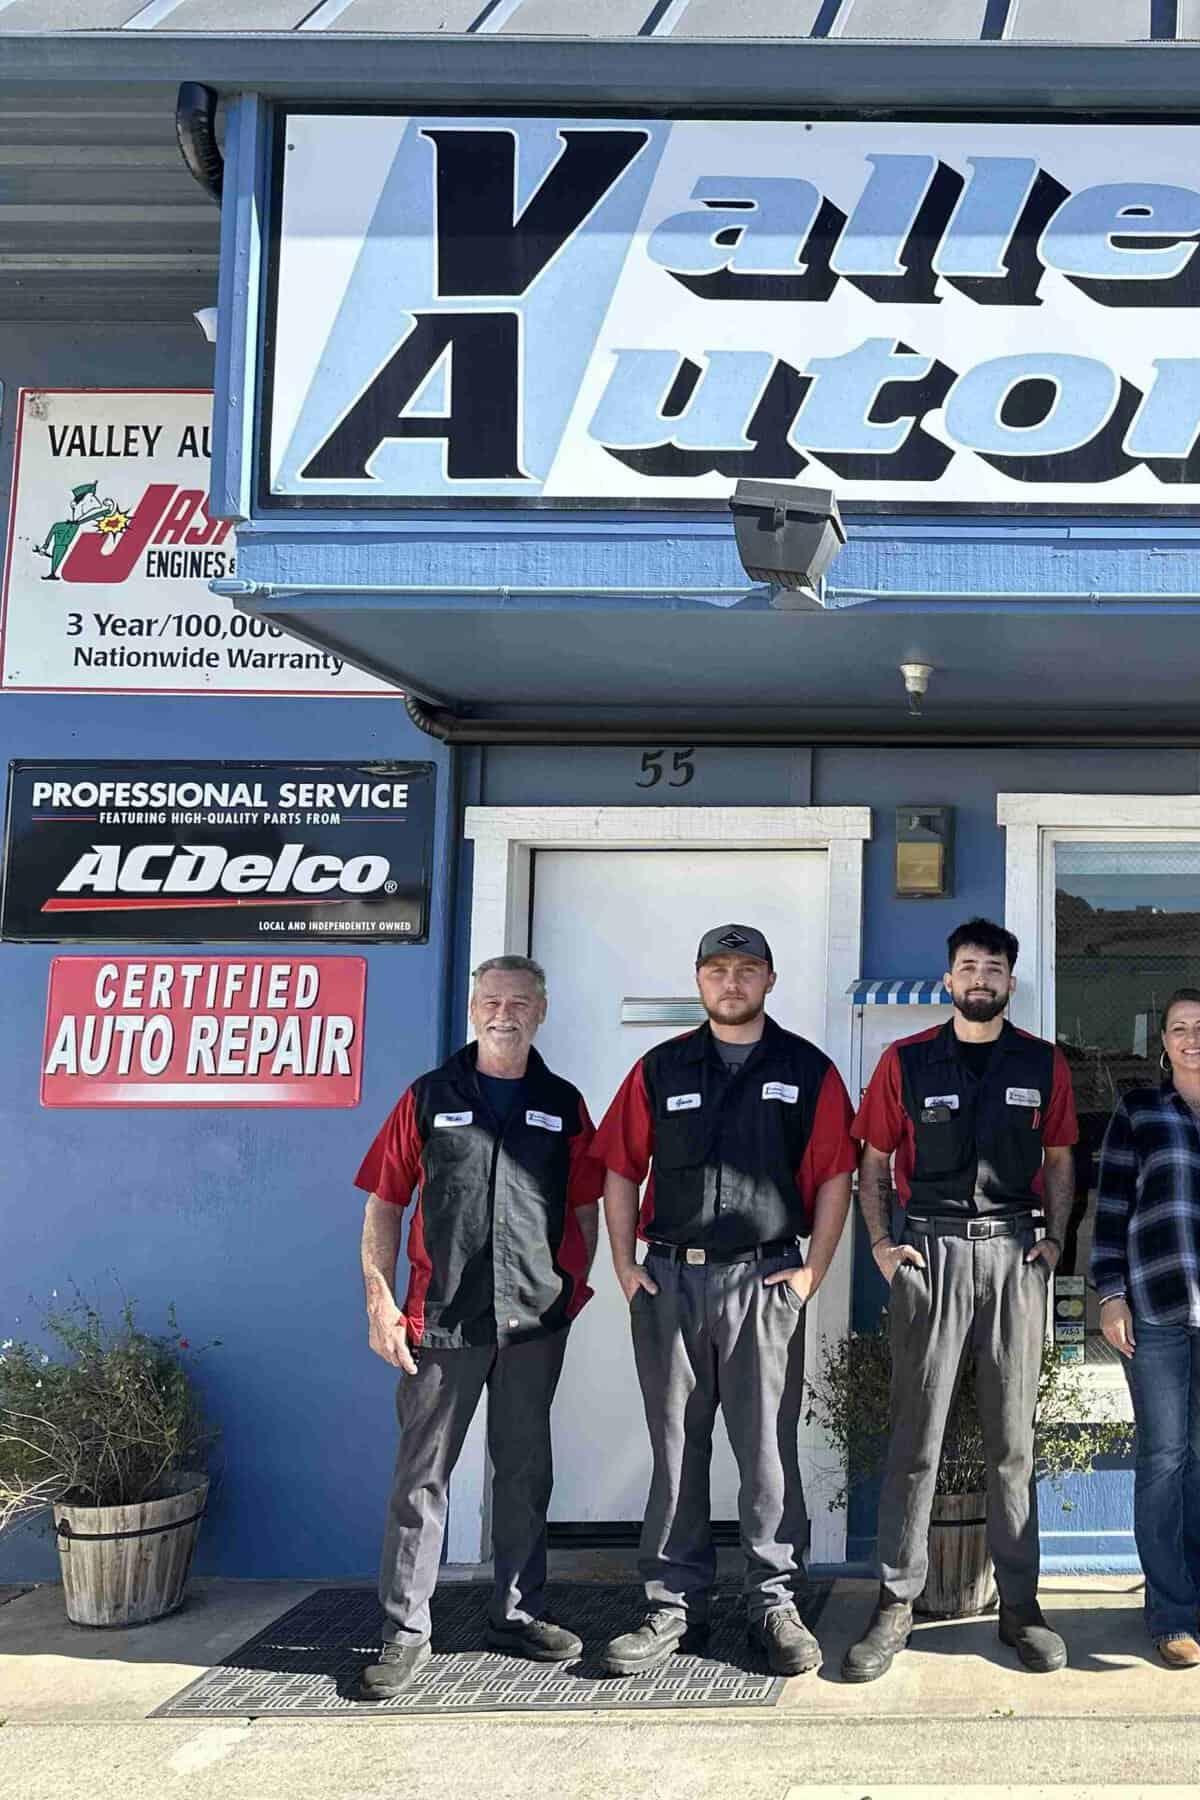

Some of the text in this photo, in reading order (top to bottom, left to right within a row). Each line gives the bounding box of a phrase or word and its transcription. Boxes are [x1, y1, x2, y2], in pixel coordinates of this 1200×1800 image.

[48, 424, 164, 458] VALLEY
[146, 551, 226, 578] ENGINES
[66, 613, 83, 636] 3
[73, 646, 344, 677] Nationwide Warranty
[635, 748, 696, 788] 55
[32, 782, 408, 808] PROFESSIONAL SERVICE
[99, 811, 341, 825] FEATURING HIGH-QUALITY PARTS FROM
[258, 920, 411, 931] LOCAL AND INDEPENDENTLY OWNED
[94, 964, 320, 1009] CERTIFIED
[45, 1015, 355, 1077] AUTO REPAIR
